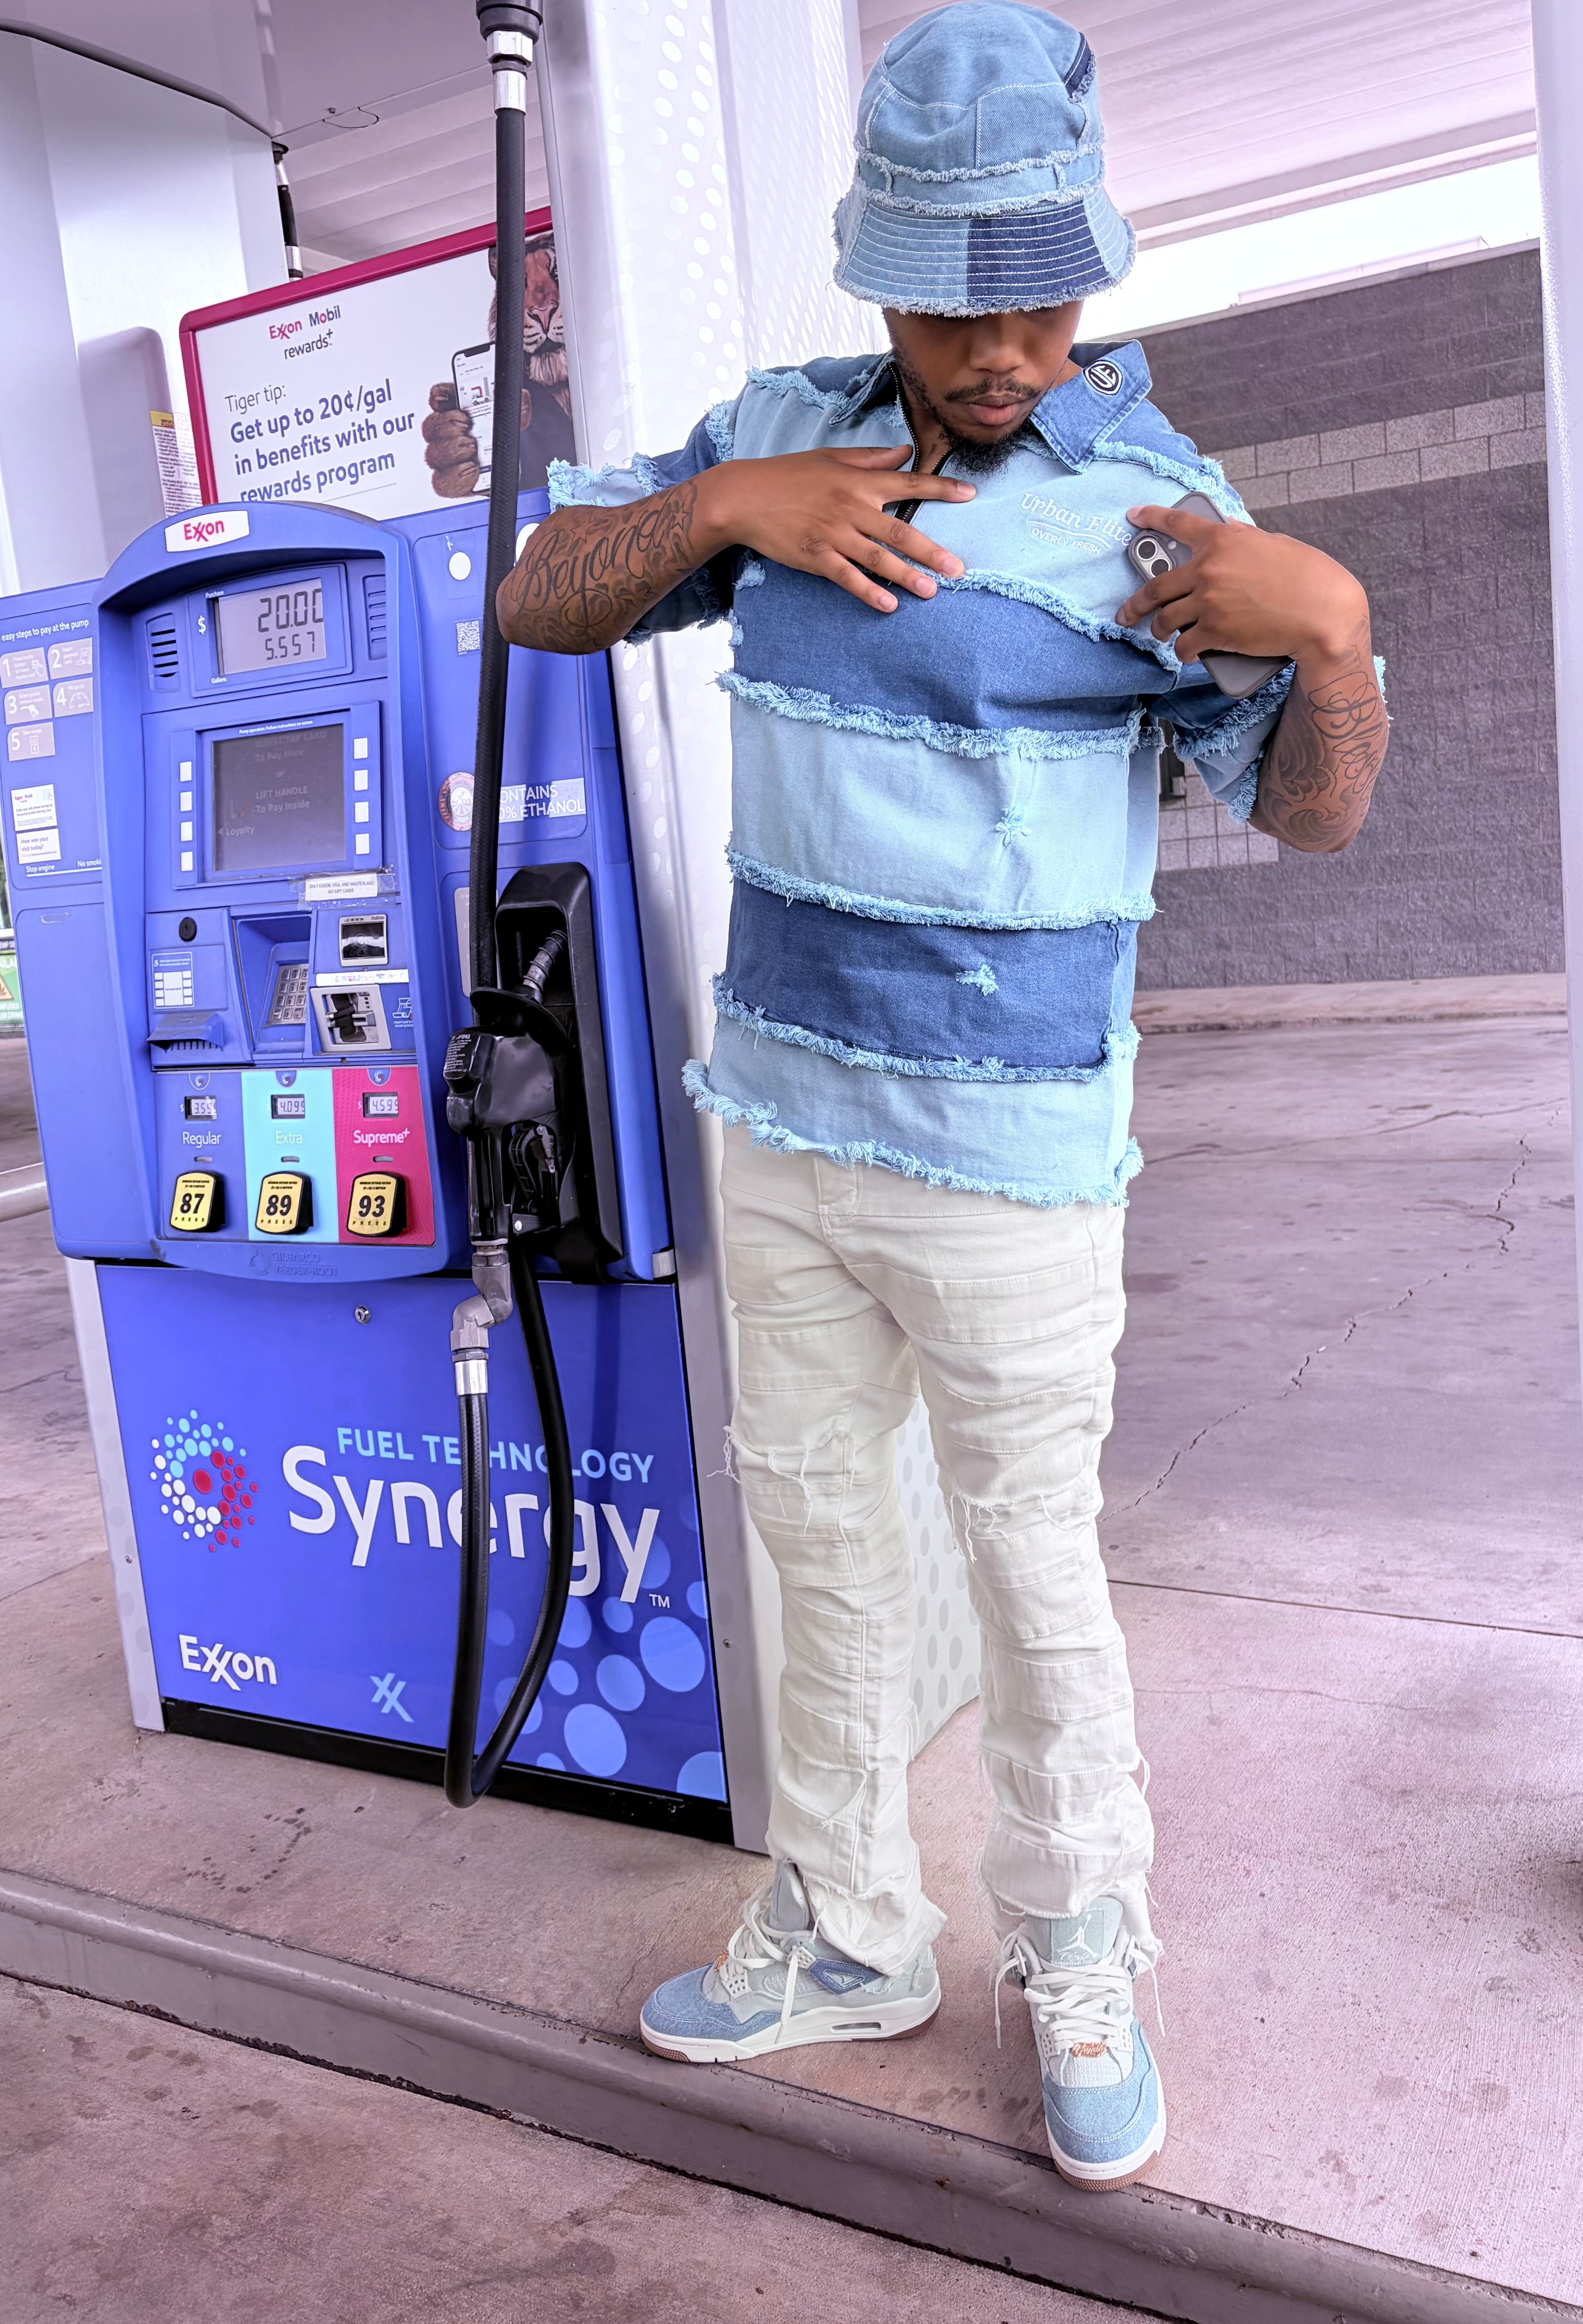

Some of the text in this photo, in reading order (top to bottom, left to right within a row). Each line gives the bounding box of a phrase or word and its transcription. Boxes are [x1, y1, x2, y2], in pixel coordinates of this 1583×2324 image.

[269, 305, 341, 340] Exxon Mobil
[225, 384, 286, 414] Tiger tip:
[230, 378, 392, 443] Get up to 20¢/gal
[234, 413, 414, 475] in benefits with our
[240, 470, 311, 502] rewards
[316, 453, 395, 494] program
[1021, 493, 1132, 546] Urban Elite
[184, 520, 225, 542] Exxon
[1031, 528, 1102, 555] OVERLY FRESH
[205, 590, 225, 598] Purchase
[258, 588, 324, 633] 20.00
[1, 633, 15, 642] easy
[16, 630, 32, 639] steps
[40, 626, 51, 637] pay
[71, 619, 89, 631] pump
[198, 615, 206, 635] $
[265, 631, 315, 660] 5.557
[2, 658, 11, 677] 1
[51, 649, 62, 668] 2
[8, 695, 17, 714] 3
[57, 687, 67, 706] 4
[11, 732, 20, 751] 5
[256, 785, 308, 800] LIFT HANDLE
[500, 784, 558, 803] ONTAINS
[256, 799, 310, 813] To Pay Inside
[499, 799, 586, 820] 0% ETHANOL
[226, 826, 255, 836] Loyalty
[38, 864, 54, 872] engine
[182, 1131, 221, 1149] Regular
[275, 1131, 302, 1144] Extra
[180, 1193, 205, 1214] 87
[266, 1194, 292, 1216] 89
[358, 1195, 385, 1217] 93
[337, 1427, 654, 1483] FUEL TEHNOGY
[648, 1593, 670, 1608] TM
[179, 1634, 277, 1691] Exxon
